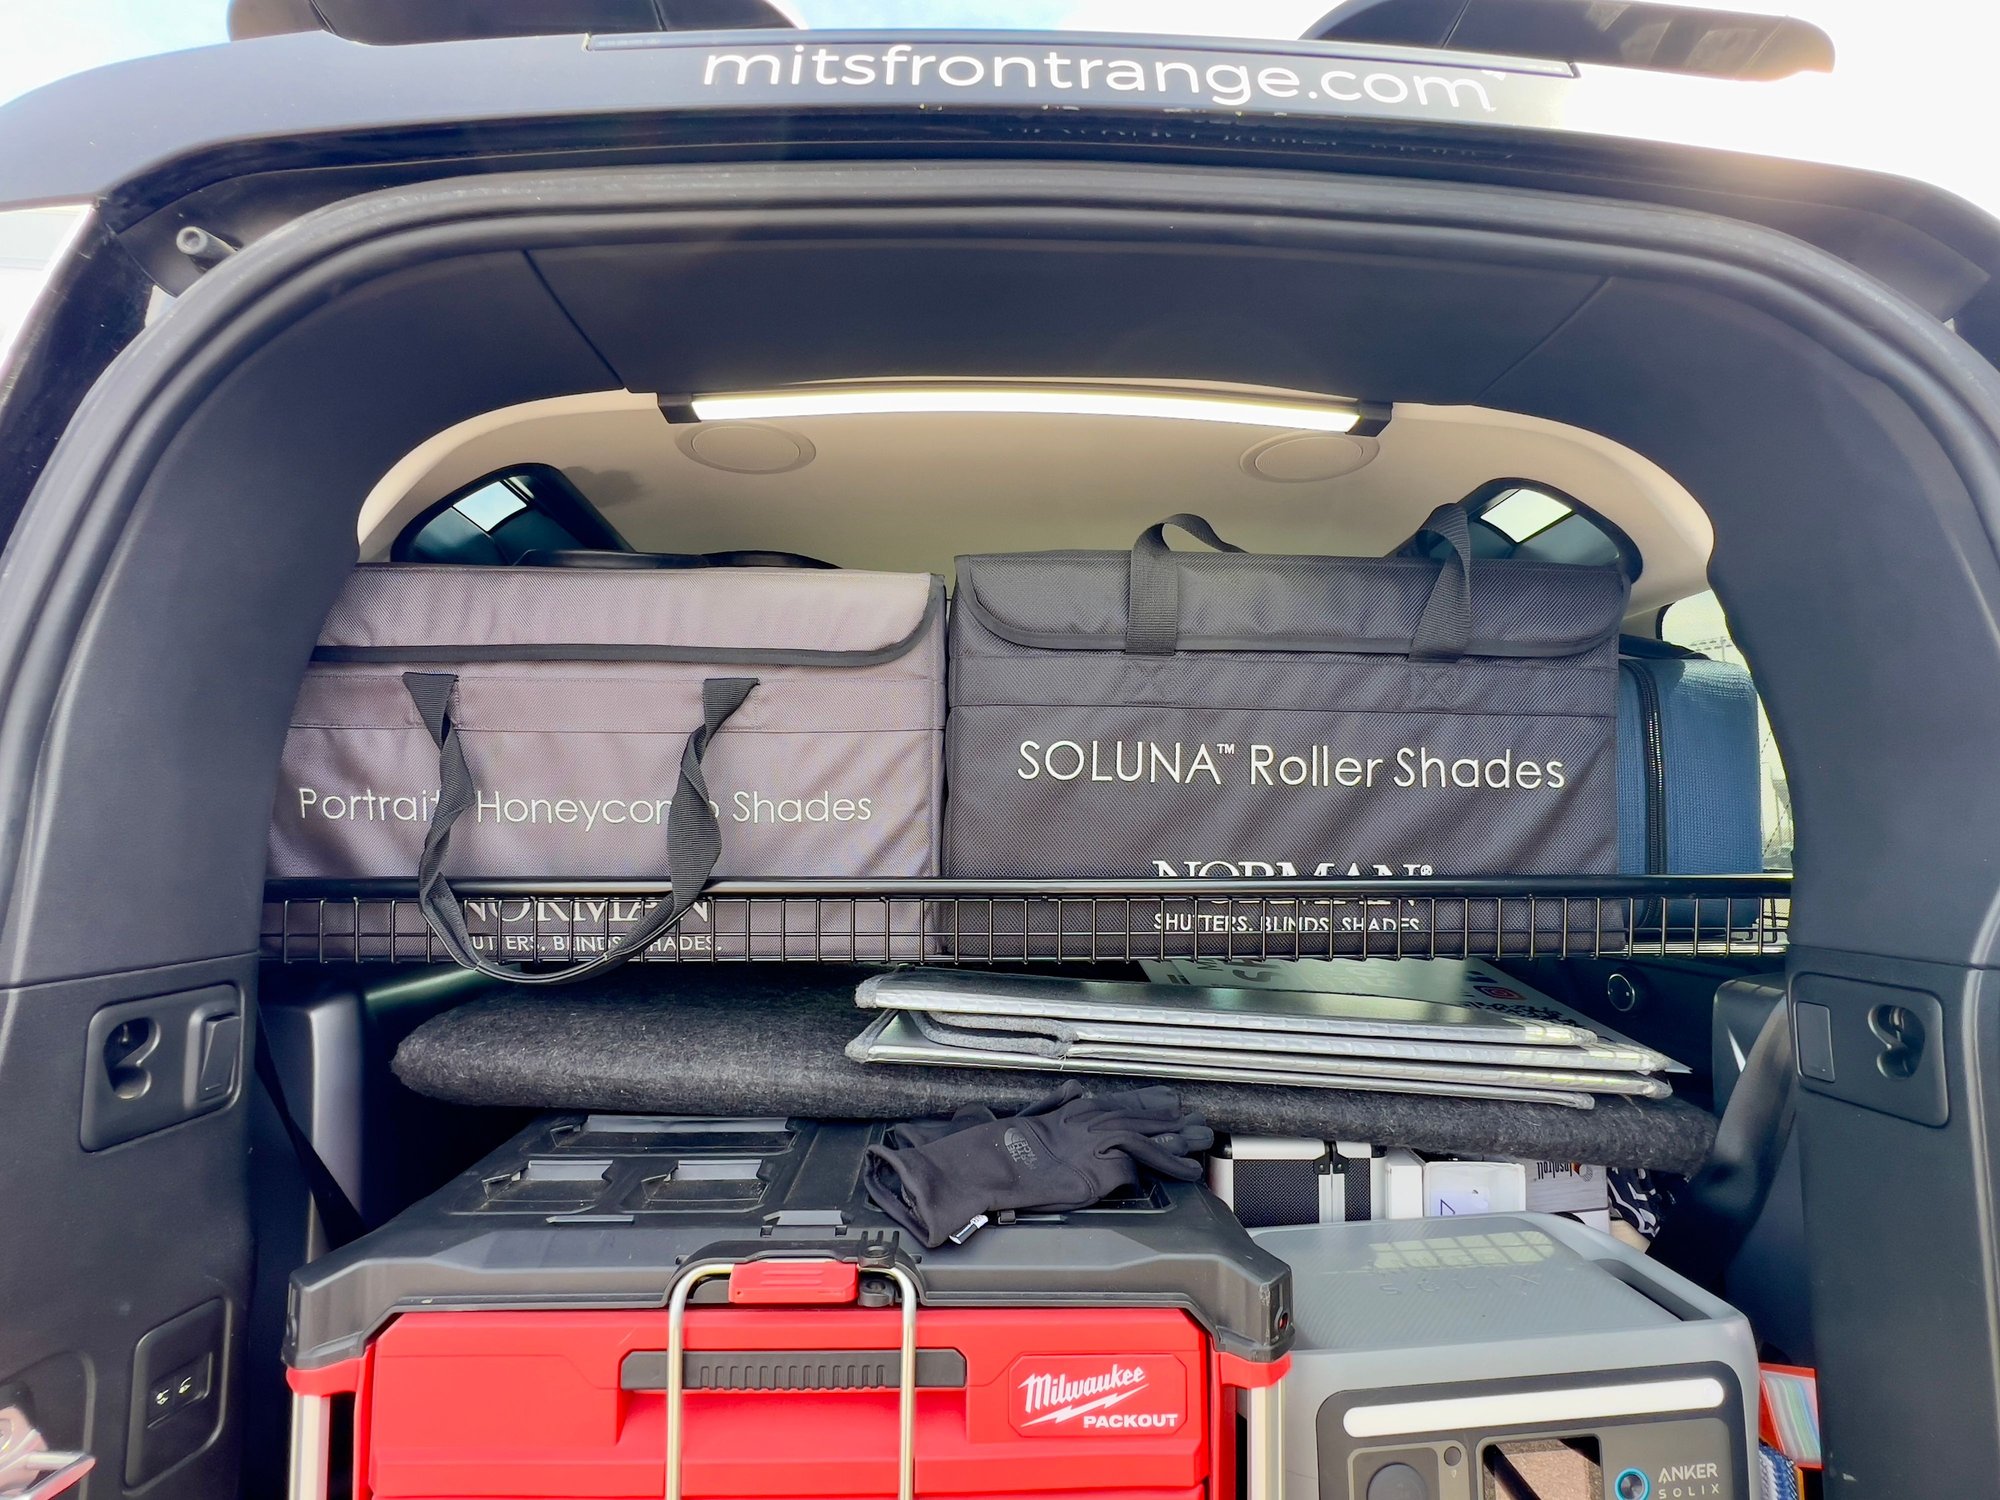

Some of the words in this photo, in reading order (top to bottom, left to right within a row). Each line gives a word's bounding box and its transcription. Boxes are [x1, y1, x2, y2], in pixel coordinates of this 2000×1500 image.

[703, 45, 1492, 112] mitsfrontrange.com
[1250, 744, 1385, 788] Roller
[1394, 746, 1566, 790] Shades
[477, 789, 719, 834] Honeyco
[732, 790, 873, 824] Shades
[649, 935, 722, 952] HADES.
[1017, 1364, 1146, 1414] Milwaukee
[1083, 1413, 1179, 1429] PACKOUT
[1658, 1462, 1719, 1483] ANKER
[1658, 1484, 1720, 1499] SOLIX
